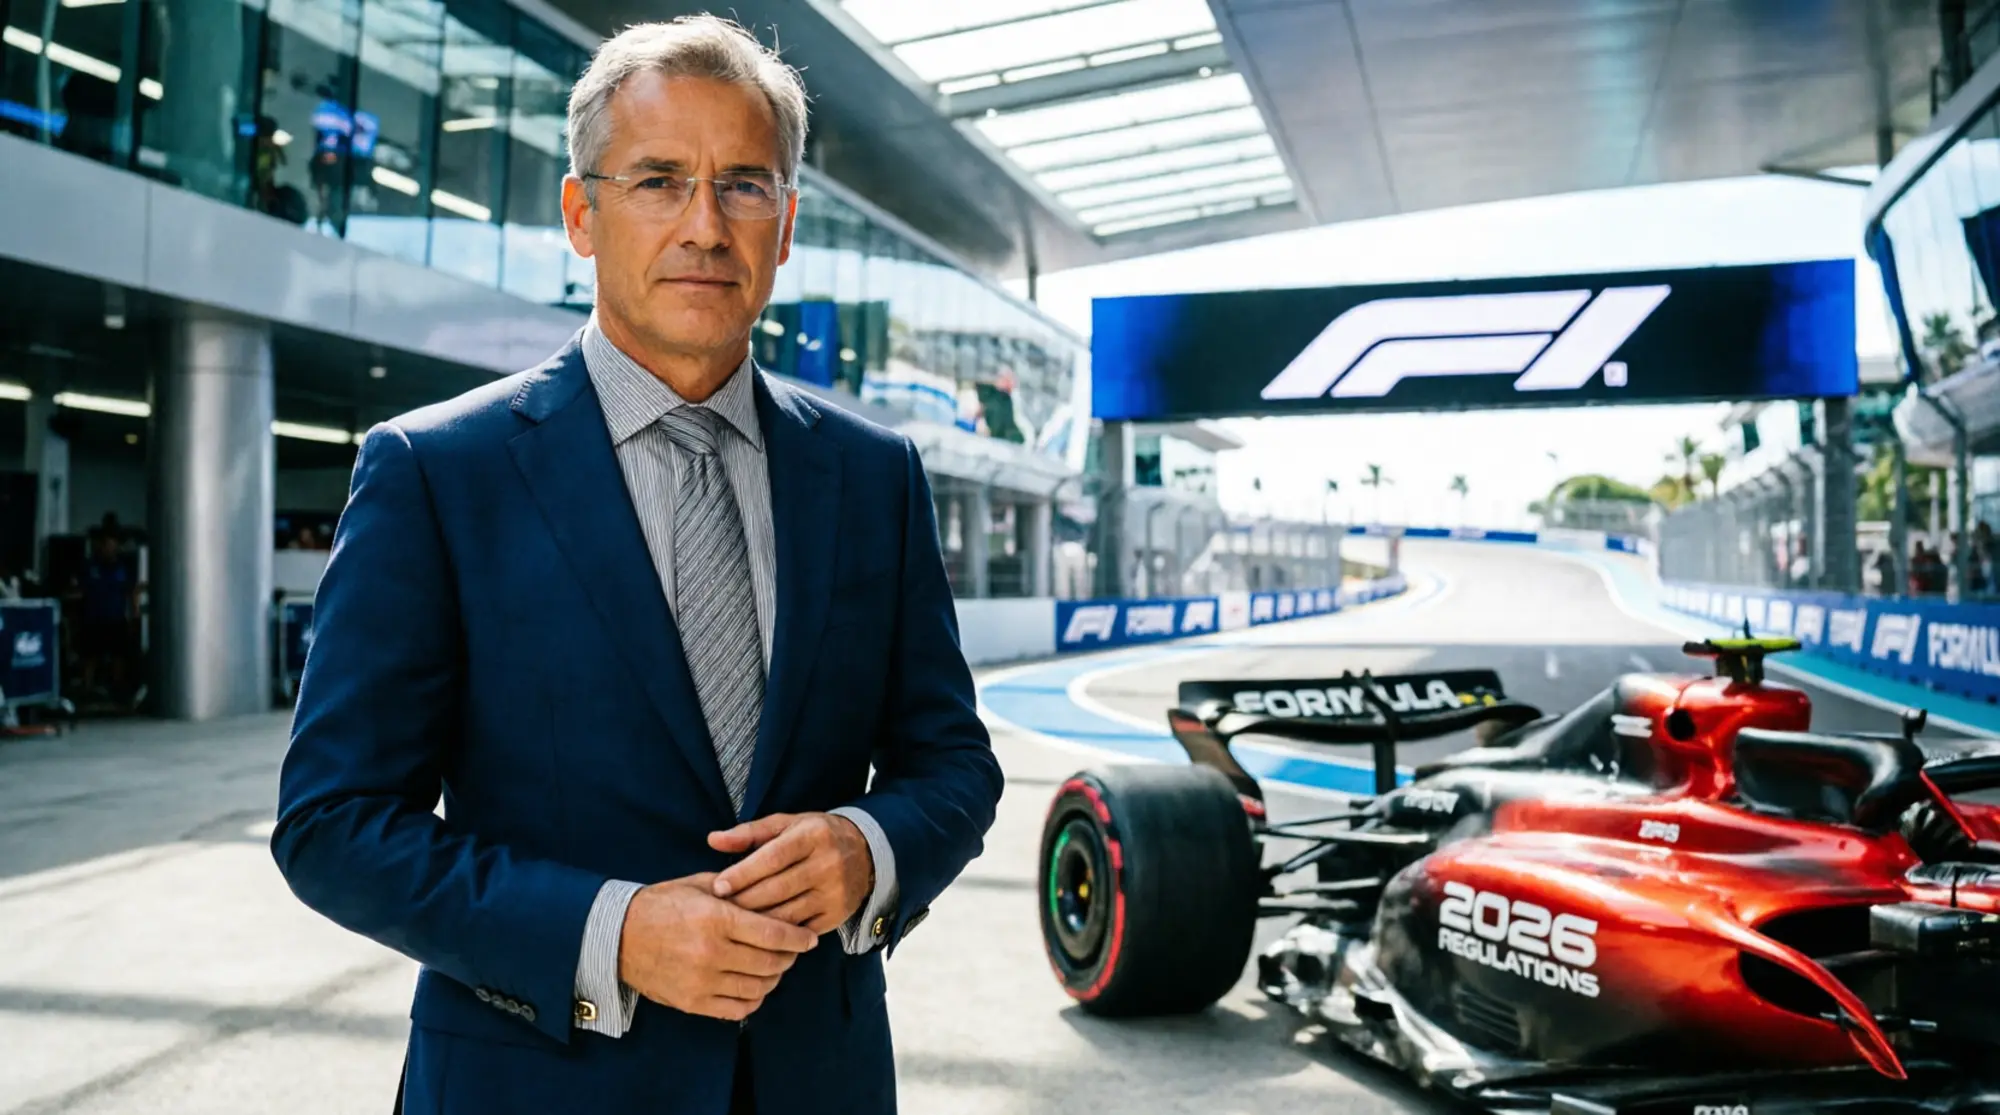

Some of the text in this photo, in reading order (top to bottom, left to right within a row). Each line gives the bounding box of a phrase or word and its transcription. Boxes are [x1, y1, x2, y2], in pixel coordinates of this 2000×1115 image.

[1262, 284, 1672, 400] F1
[1438, 927, 1600, 998] REGULATIONS
[1439, 880, 1599, 968] 2026
